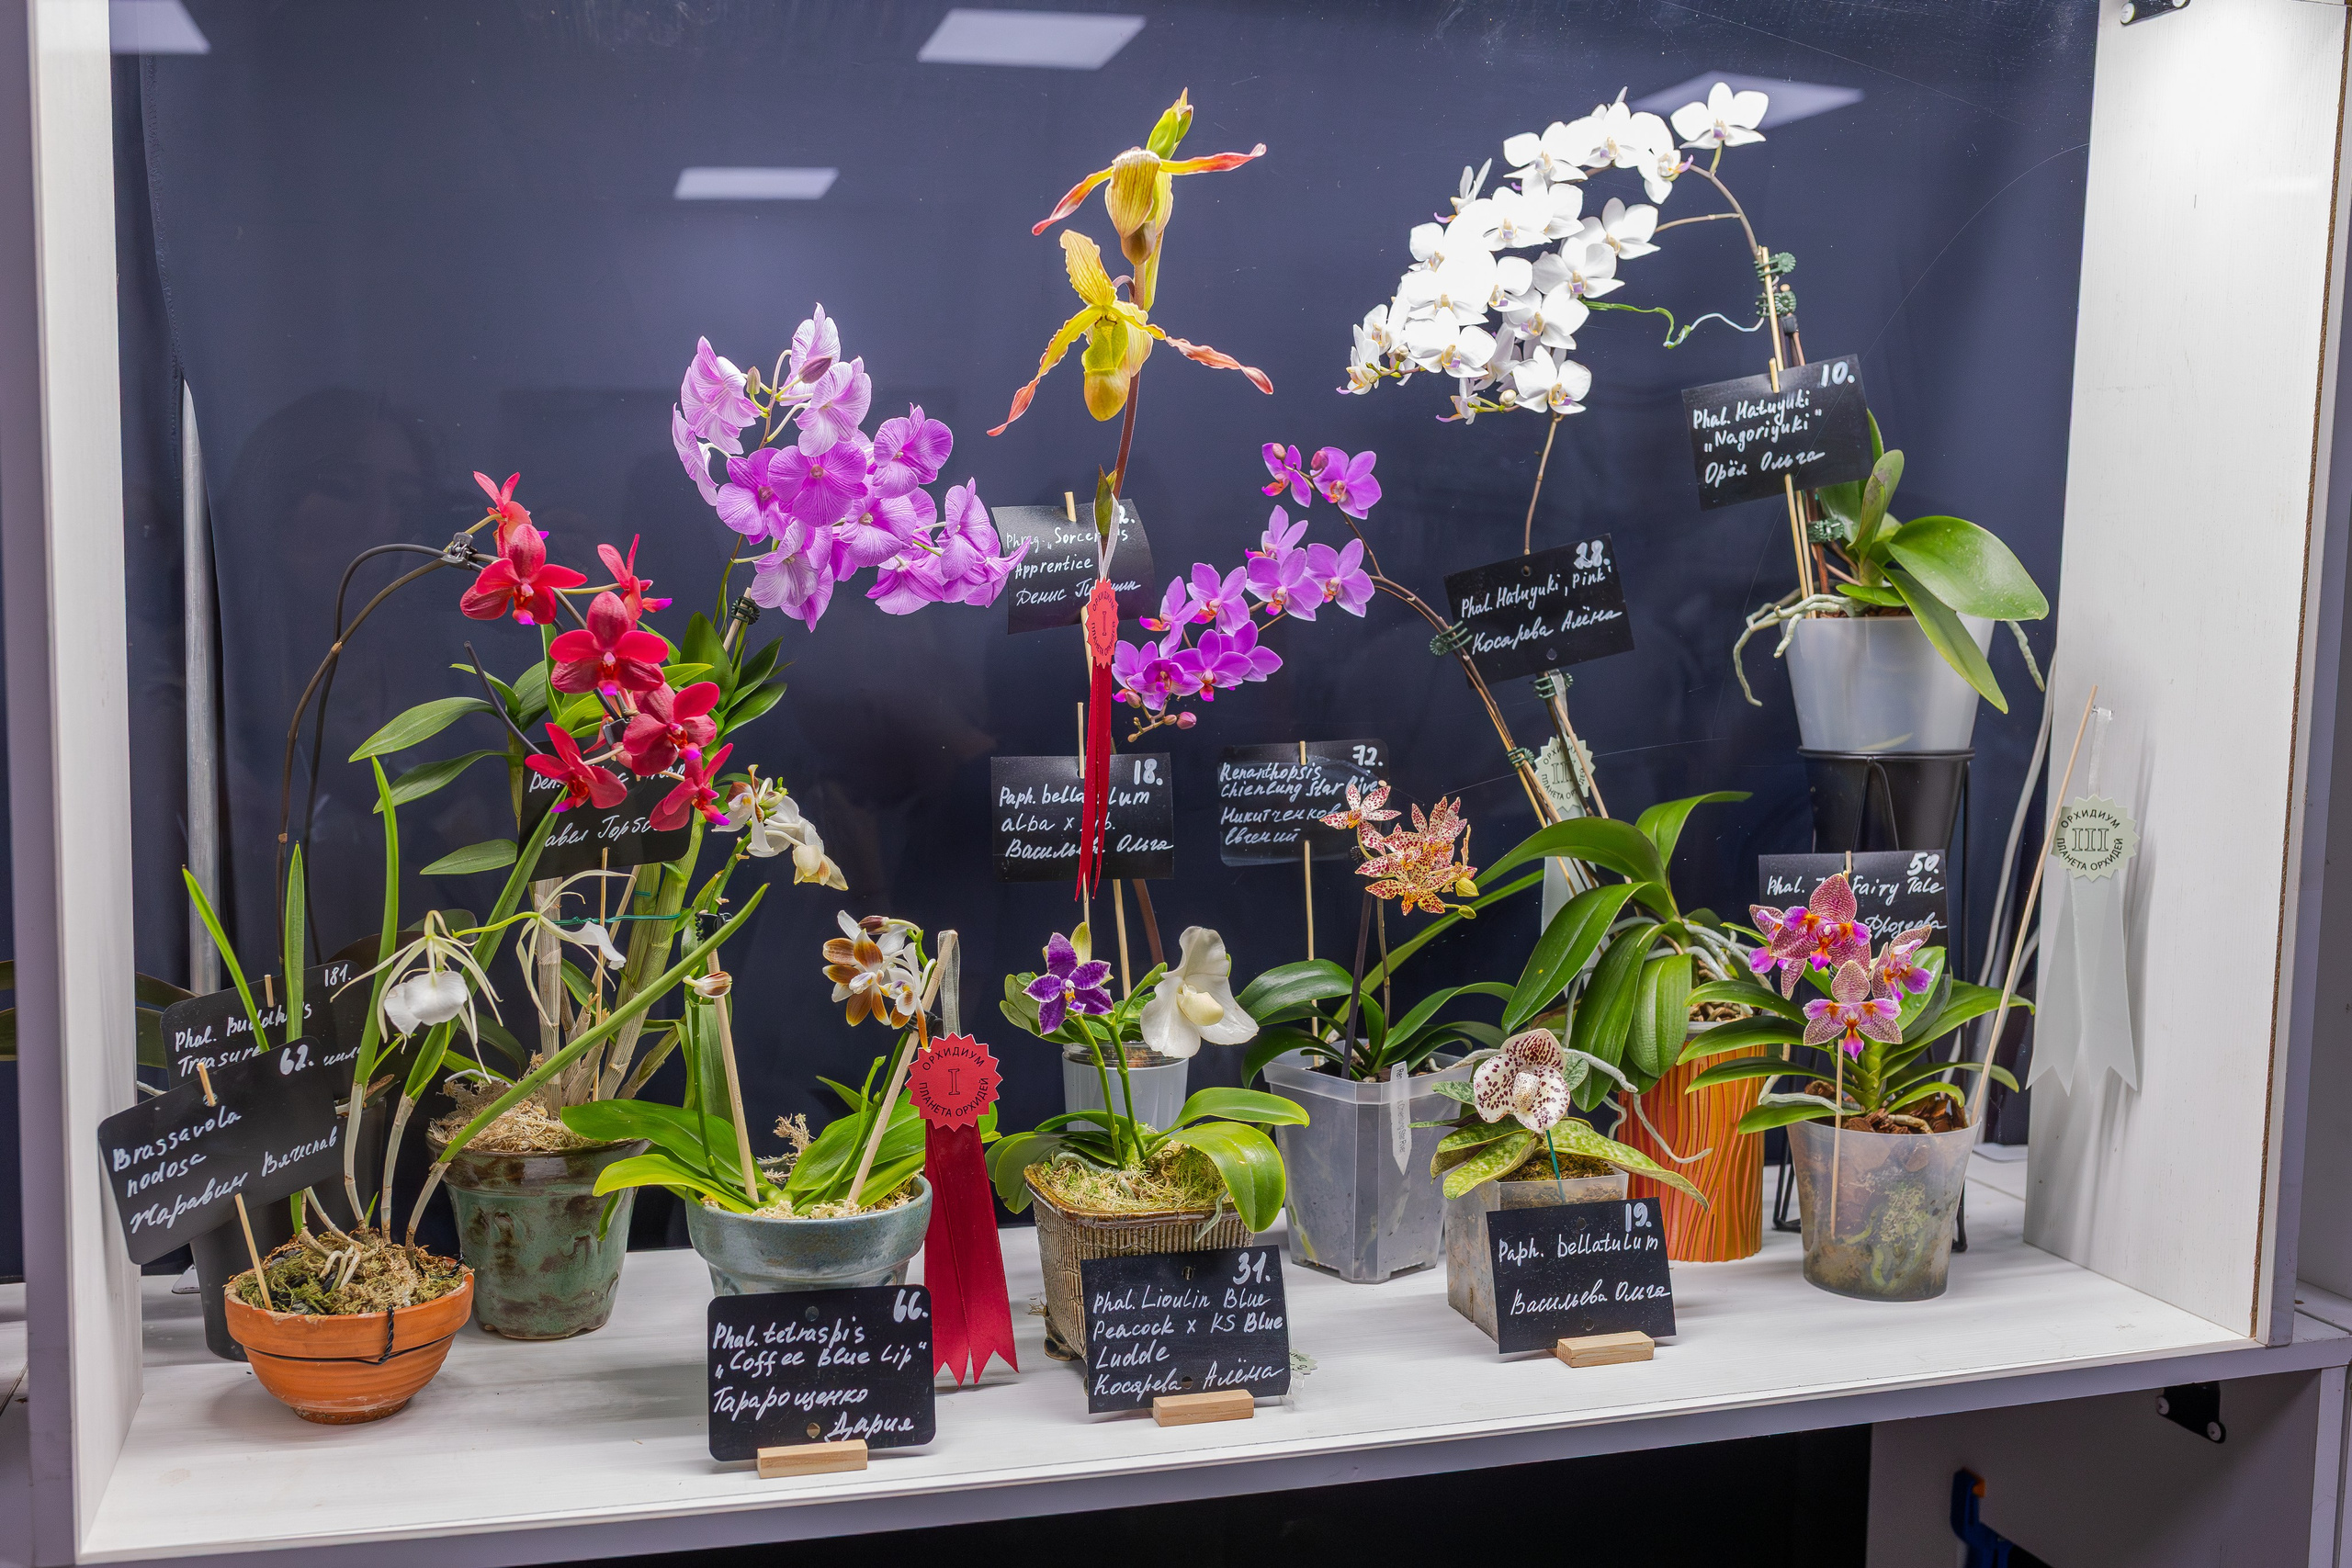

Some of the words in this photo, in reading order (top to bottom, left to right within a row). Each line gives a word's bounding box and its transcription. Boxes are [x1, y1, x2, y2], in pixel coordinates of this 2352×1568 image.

[1820, 361, 1856, 388] 10.
[1692, 406, 1731, 429] Phal.
[1760, 450, 1826, 471] Ольга
[1014, 554, 1093, 580] Apprentice
[1574, 539, 1611, 570] 28.
[1016, 588, 1067, 606] Денис
[1461, 595, 1493, 618] Phal.
[1472, 616, 1554, 656] Косарева
[1561, 606, 1623, 632] Алёна
[1352, 744, 1384, 766] 72.
[1134, 758, 1163, 785] 18.
[999, 785, 1035, 809] Paph.
[1041, 784, 1150, 807] bellalum
[1221, 781, 1303, 803] Chienlung
[1306, 778, 1344, 797] Star
[1542, 773, 1565, 800] ПЛАНЕТА
[1001, 813, 1055, 832] alba
[2060, 809, 2120, 829] ОРХИДИУМ
[543, 822, 589, 848] авел
[1116, 834, 1174, 852] Ольга
[1225, 827, 1302, 846] Евгений
[2072, 828, 2109, 852] III
[1906, 852, 1941, 876] 50.
[2056, 838, 2087, 870] ПЛАНЕТА
[2090, 838, 2123, 871] ОРХИДЕЙ
[1767, 875, 1805, 896] Phal.
[1850, 875, 1899, 906] Fairy
[1907, 876, 1945, 895] Tale
[324, 964, 352, 987] 181.
[175, 1025, 217, 1053] Phal.
[279, 1044, 315, 1076] 62.
[922, 1047, 985, 1071] ОРХИДИУМ
[919, 1082, 952, 1117] ПЛАНЕТА
[955, 1077, 989, 1117] ОРХИДЕЙ
[112, 1105, 242, 1172] Brassavola
[127, 1153, 207, 1198] nodosa
[1625, 1201, 1653, 1233] 19.
[1498, 1237, 1544, 1267] Paph.
[1232, 1251, 1272, 1285] 31.
[893, 1289, 929, 1323] 66.
[1092, 1291, 1136, 1314] Phal.
[1223, 1287, 1272, 1309] Blue
[1510, 1279, 1608, 1315] Васильева
[1615, 1280, 1671, 1302] Ольга
[713, 1322, 759, 1349] Phal.
[763, 1315, 865, 1349] tetraspis
[1092, 1314, 1175, 1342] Peacock
[1209, 1312, 1237, 1334] KS
[1243, 1311, 1283, 1333] Blue
[817, 1347, 871, 1367] Blue
[1203, 1357, 1285, 1390] Алёна
[823, 1411, 914, 1443] Дария
